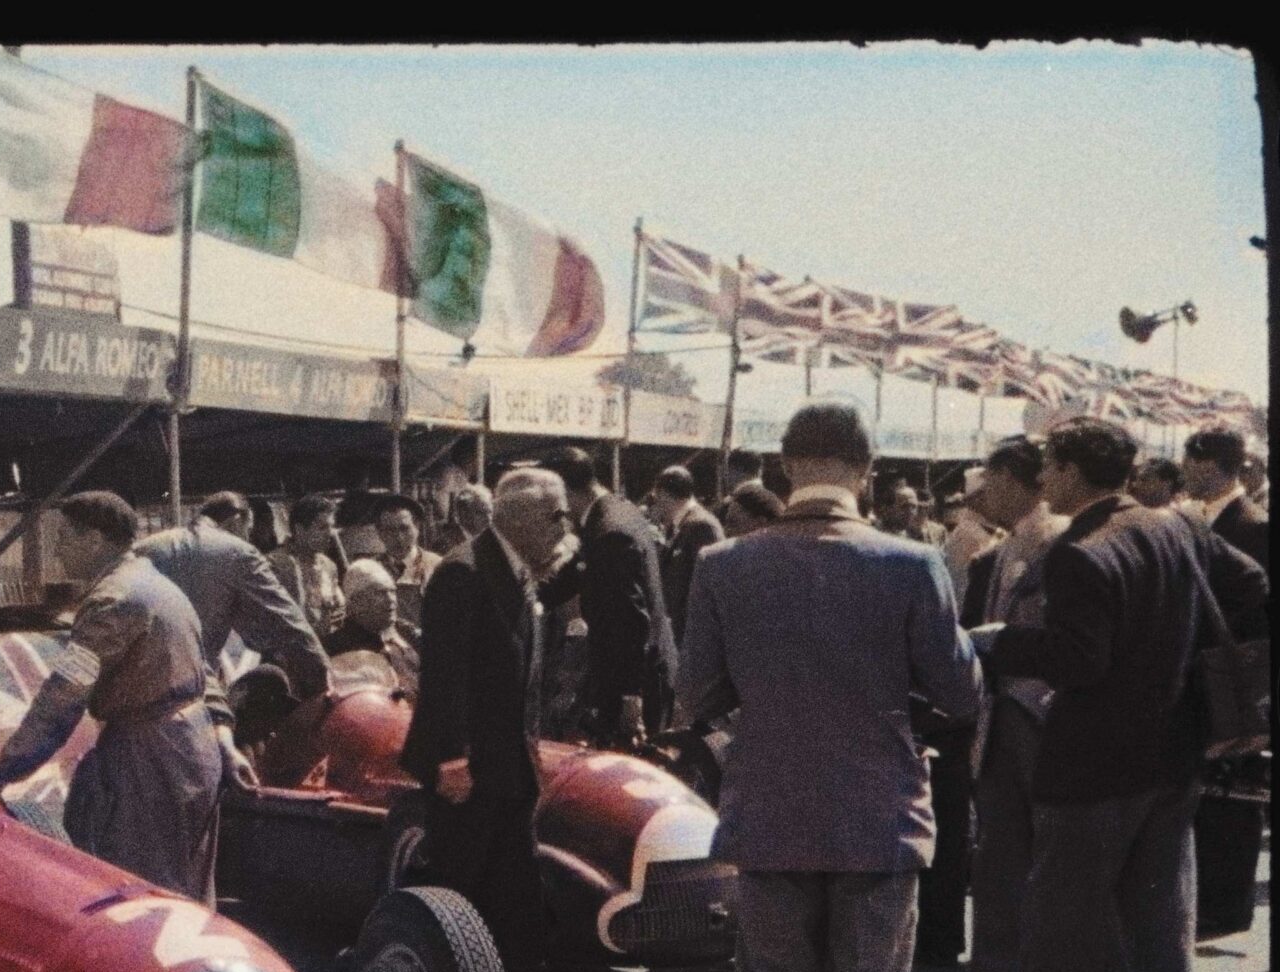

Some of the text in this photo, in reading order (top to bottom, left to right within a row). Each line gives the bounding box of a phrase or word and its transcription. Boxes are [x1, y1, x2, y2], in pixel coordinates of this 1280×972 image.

[14, 317, 34, 375] 3
[39, 331, 89, 374] ALFA
[95, 337, 161, 379] ROMEO
[194, 354, 280, 398] PARNELL
[289, 364, 303, 405] 4
[106, 897, 251, 968] 2
